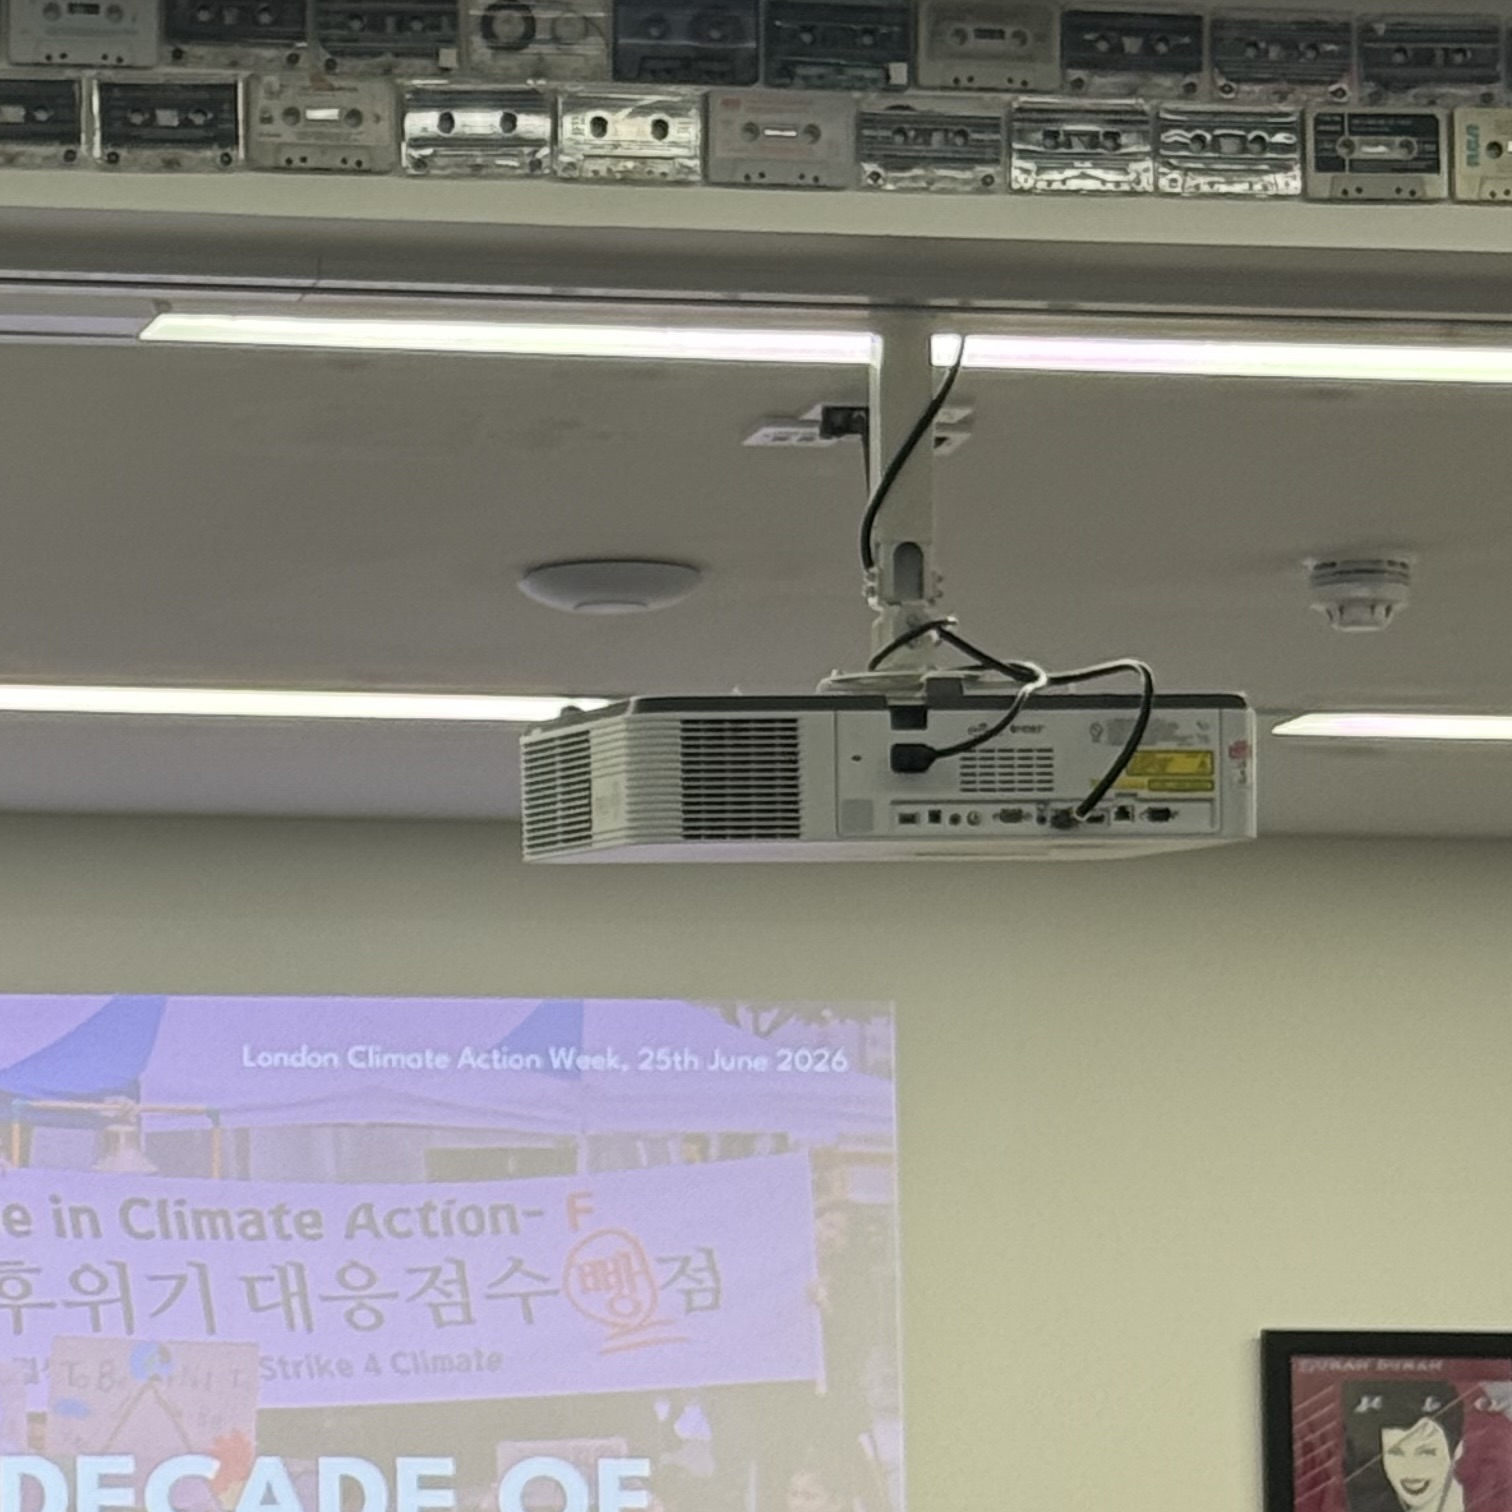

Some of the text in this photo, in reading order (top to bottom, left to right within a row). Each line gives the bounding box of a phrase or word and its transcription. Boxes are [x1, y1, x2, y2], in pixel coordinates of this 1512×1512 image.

[242, 1044, 849, 1073] London Climate Action Week, 25th June 2026
[48, 1193, 104, 1240] in
[117, 1197, 325, 1242] Climate
[566, 1190, 595, 1232] F
[259, 1352, 355, 1381] Strike
[363, 1352, 383, 1377] 4
[390, 1348, 505, 1376] Climate
